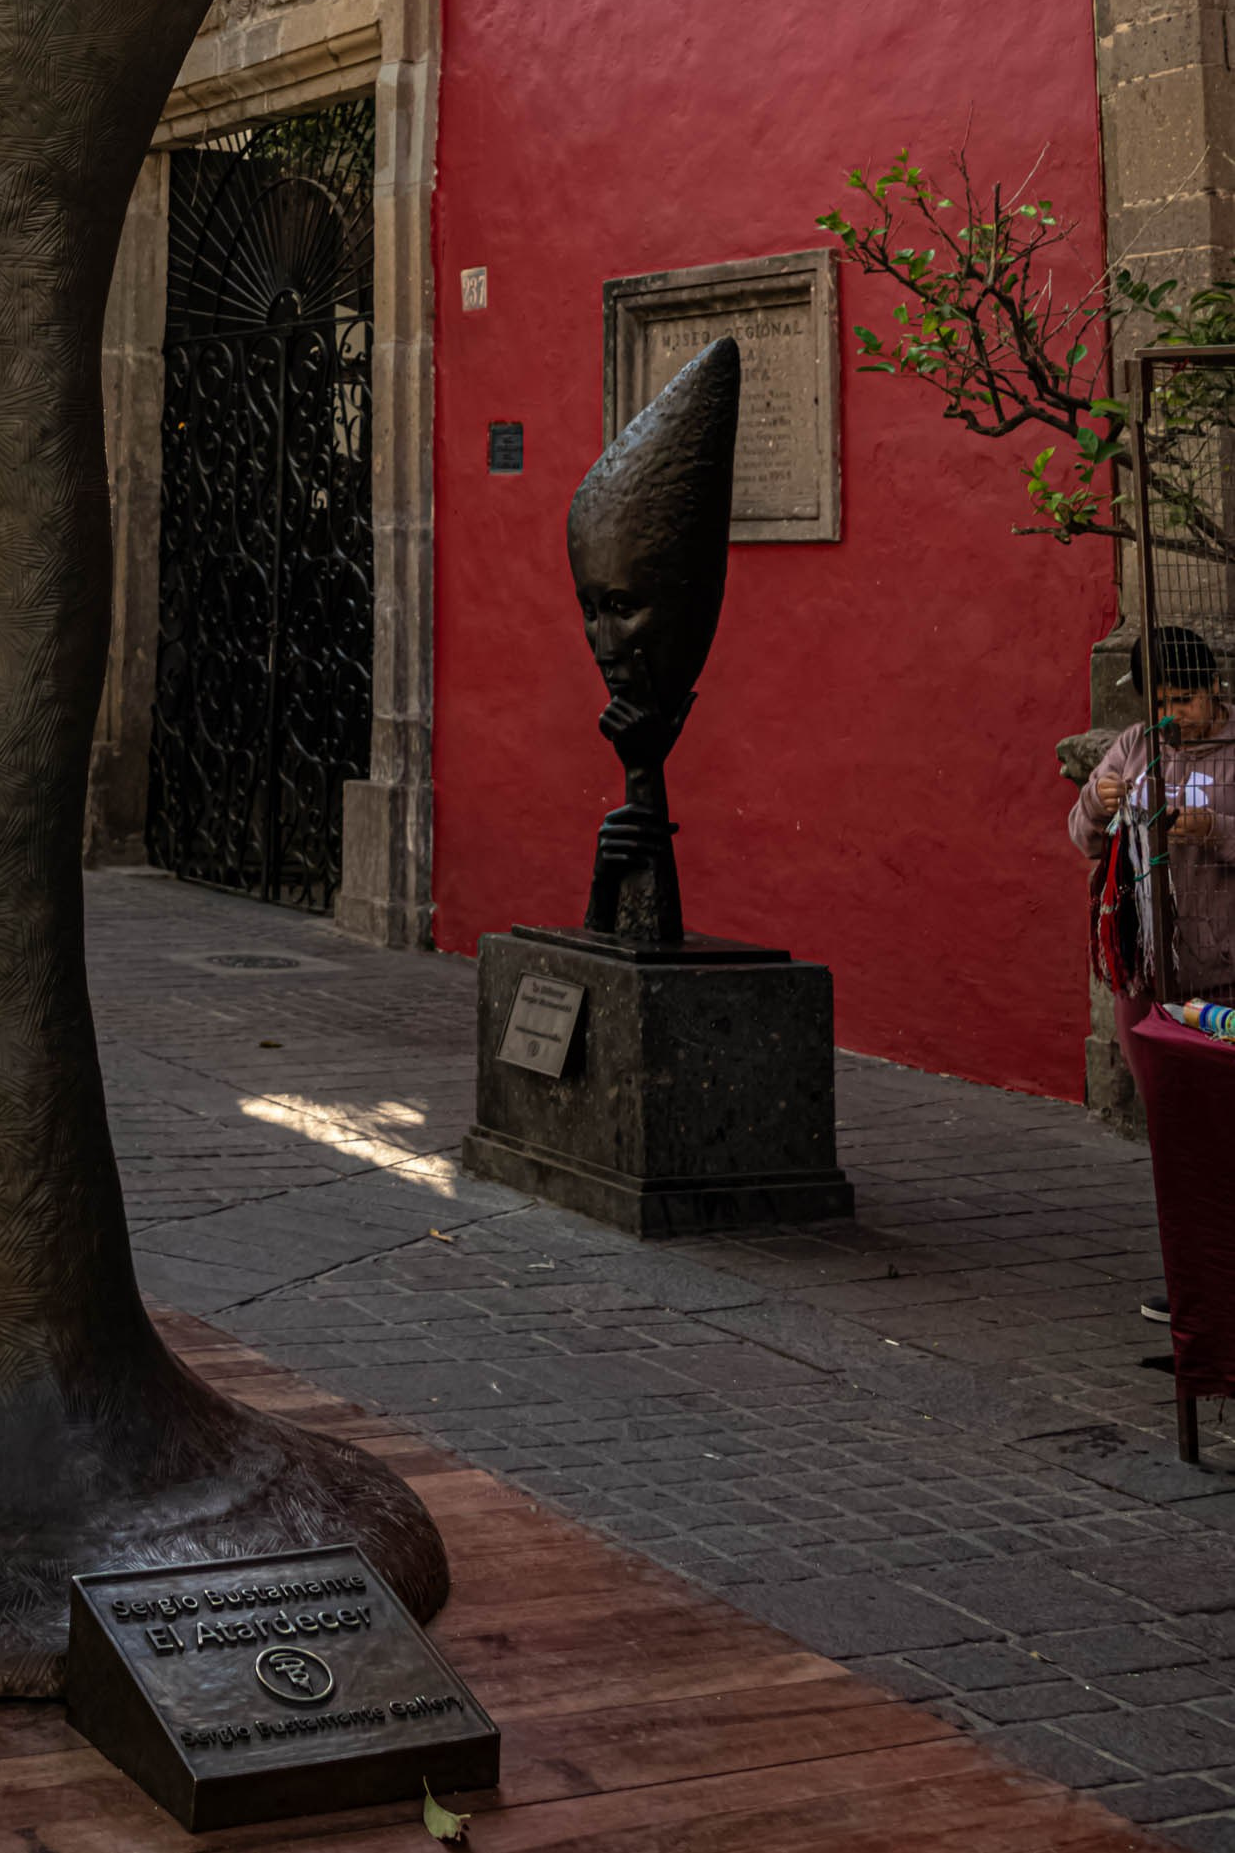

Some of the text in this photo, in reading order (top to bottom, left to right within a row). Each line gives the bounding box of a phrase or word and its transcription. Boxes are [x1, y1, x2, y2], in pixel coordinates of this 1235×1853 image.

[662, 331, 711, 348] MUSEO
[110, 1573, 367, 1619] Sergio Bustamante
[145, 1603, 371, 1654] El Atardecer
[180, 1695, 464, 1748] Sergio Bustamante Gallery
